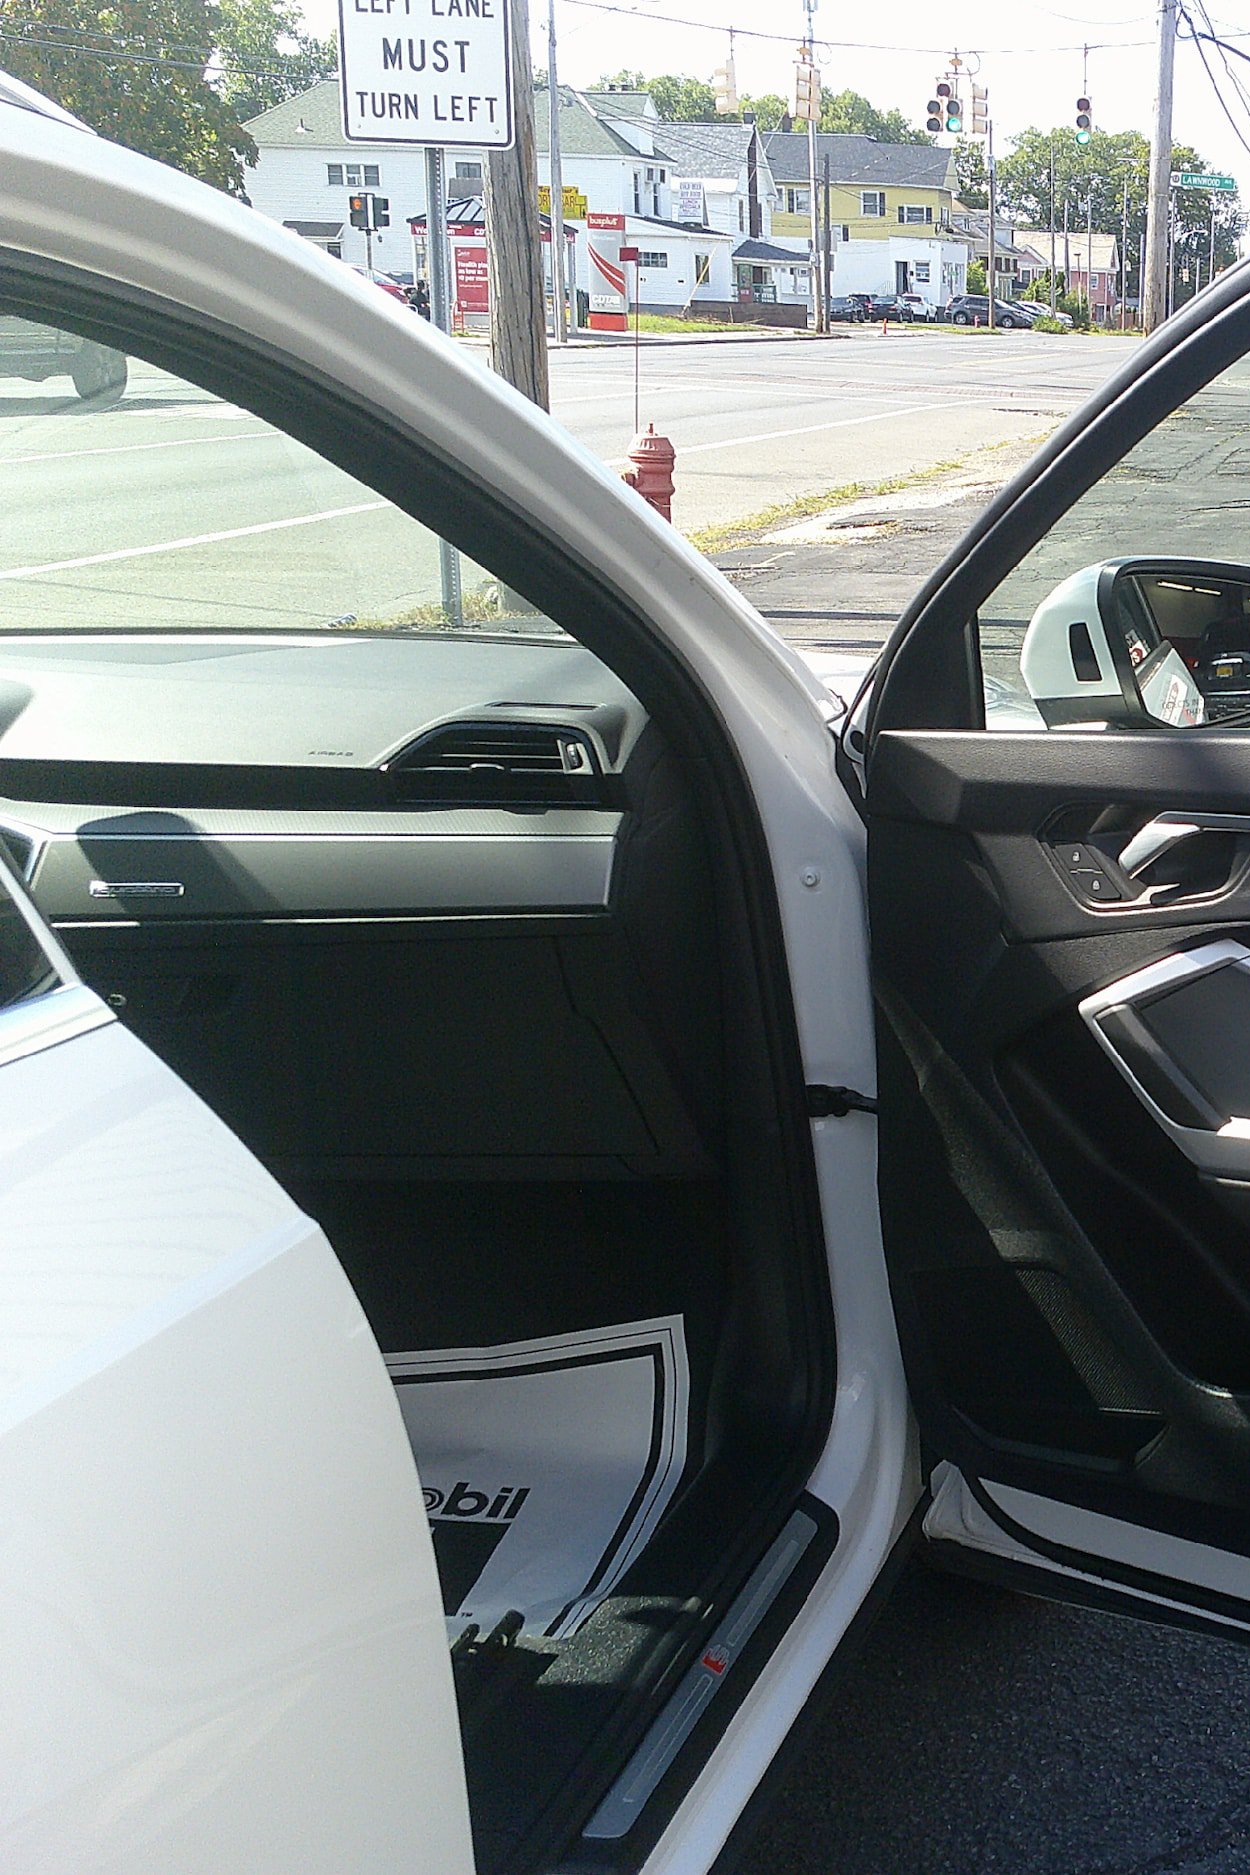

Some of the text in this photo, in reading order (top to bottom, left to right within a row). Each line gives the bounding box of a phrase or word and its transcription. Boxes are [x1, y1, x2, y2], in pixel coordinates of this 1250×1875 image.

[431, 0, 494, 18] LANE
[382, 37, 470, 73] MUST
[355, 91, 498, 123] TURN LEFT
[1182, 175, 1221, 187] LAWNWOOD
[420, 1482, 531, 1518] obil
